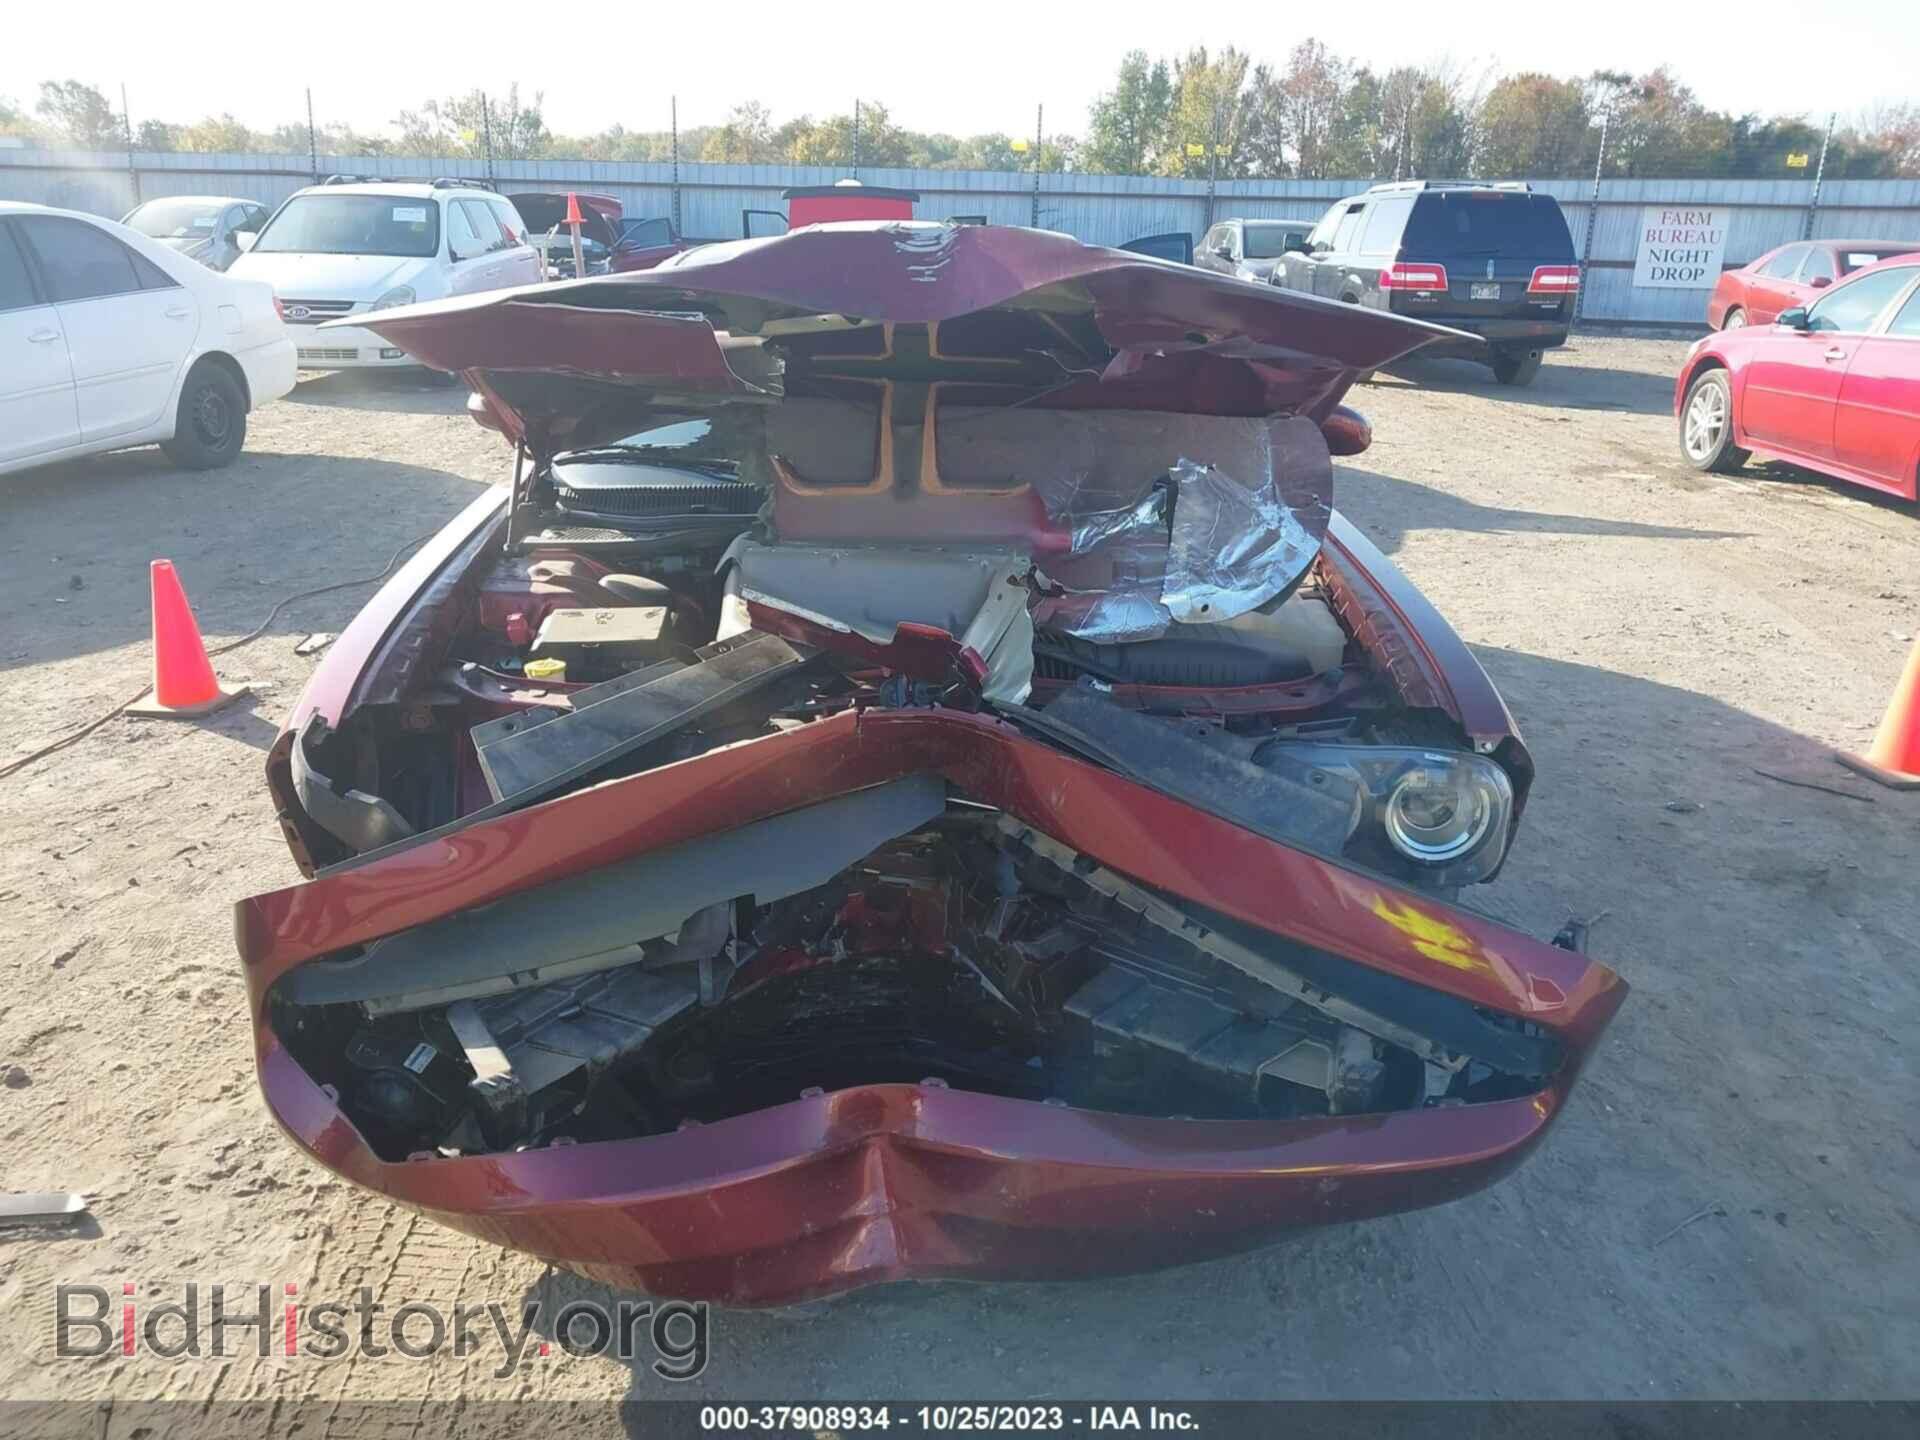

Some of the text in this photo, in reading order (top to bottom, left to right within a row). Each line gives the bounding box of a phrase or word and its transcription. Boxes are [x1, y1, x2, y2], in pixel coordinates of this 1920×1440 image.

[1661, 210, 1712, 226] FARM
[1645, 228, 1722, 244] BUREAU
[1648, 248, 1712, 264] NIGHT
[1650, 266, 1705, 281] DROP
